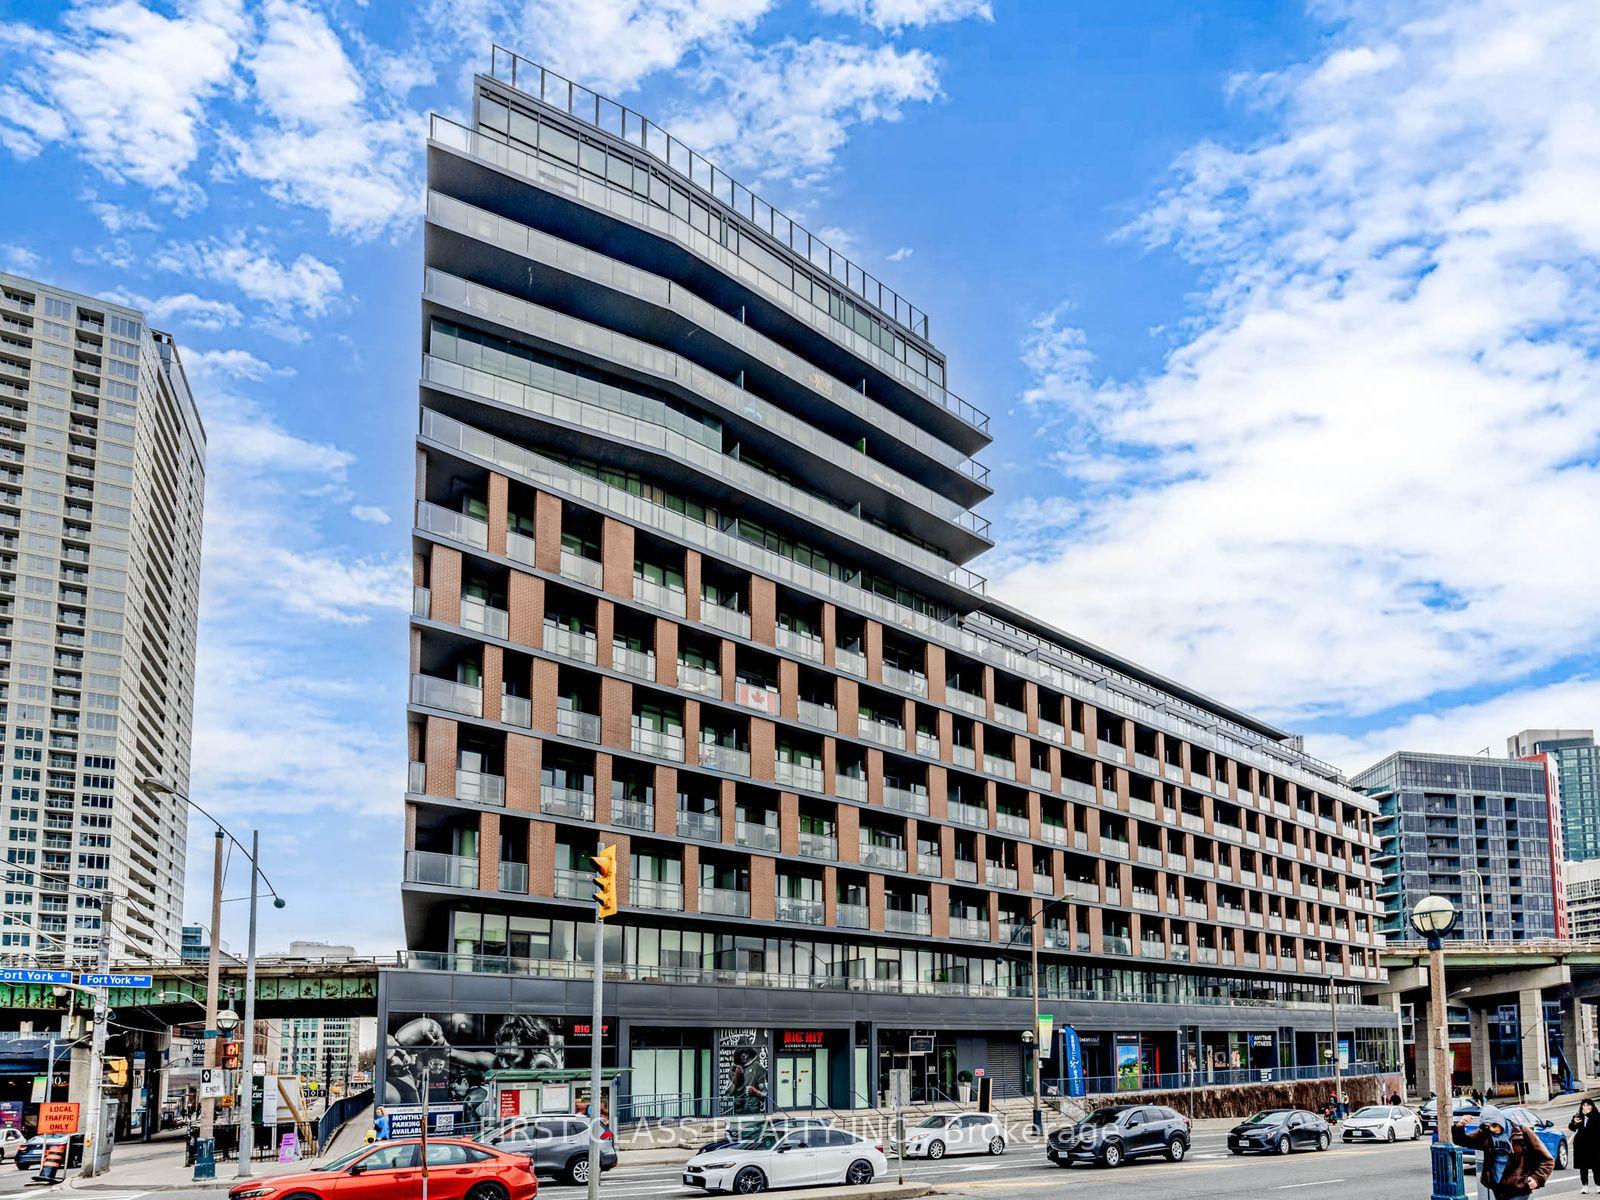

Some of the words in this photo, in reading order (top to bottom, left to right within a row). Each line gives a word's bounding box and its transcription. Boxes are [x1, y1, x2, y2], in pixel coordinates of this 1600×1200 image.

[0, 970, 23, 980] Fort
[27, 971, 54, 981] York
[87, 975, 108, 984] Fort
[110, 976, 131, 985] York
[574, 1025, 590, 1033] BIG
[784, 1031, 803, 1043] BIG
[806, 1031, 823, 1043] HIT
[205, 1086, 221, 1094] ENDS
[392, 1113, 422, 1121] MONTHLY
[49, 1123, 70, 1131] ONLY
[391, 1127, 422, 1135] AVAILABL
